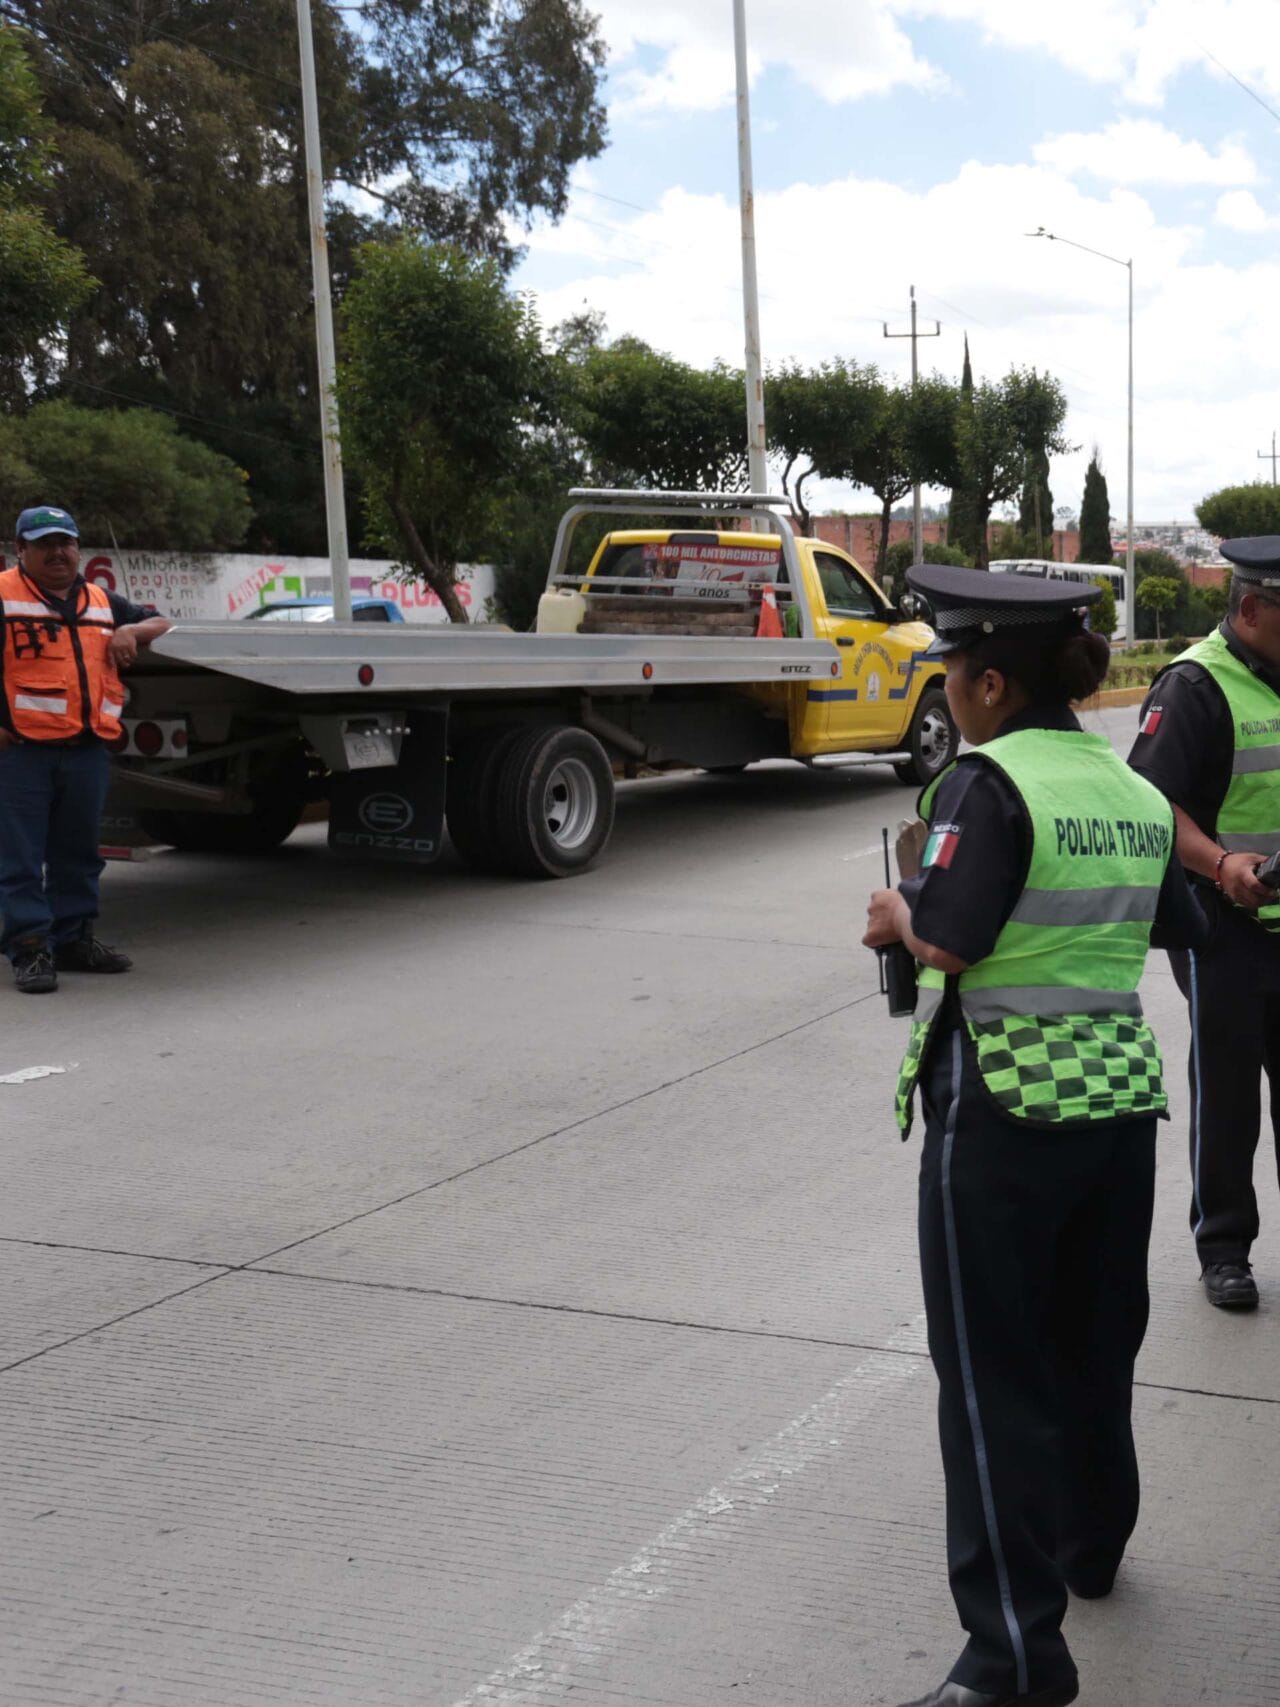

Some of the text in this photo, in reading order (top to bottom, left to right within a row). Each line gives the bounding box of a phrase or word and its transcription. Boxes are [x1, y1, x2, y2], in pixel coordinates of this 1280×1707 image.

[661, 546, 778, 562] 100 MIL ANTORCHISTAS
[1241, 719, 1269, 737] POLICIA
[1053, 817, 1118, 857] POLICIA
